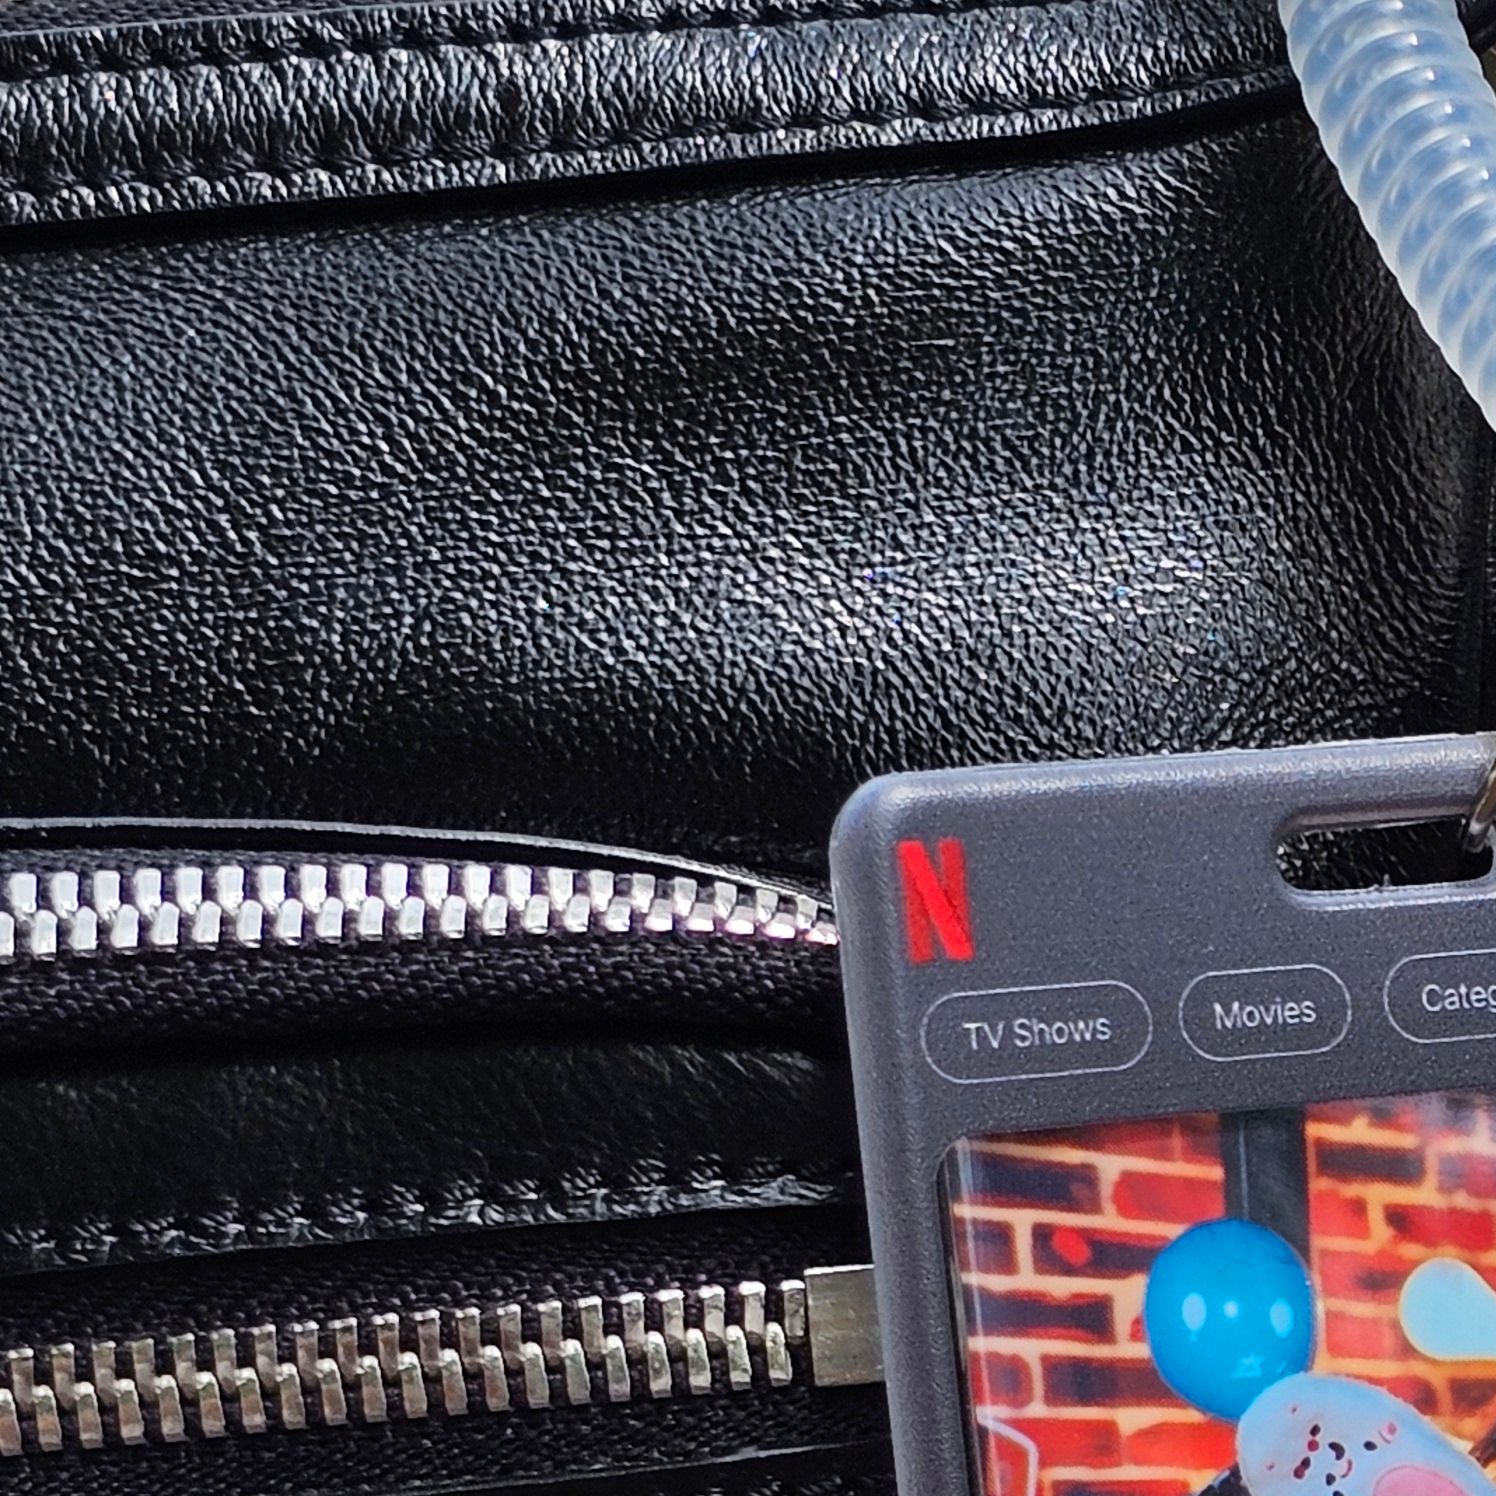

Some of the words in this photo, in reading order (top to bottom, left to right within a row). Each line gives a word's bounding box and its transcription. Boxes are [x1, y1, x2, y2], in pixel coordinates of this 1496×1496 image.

[1214, 998, 1317, 1031] Movies
[963, 1021, 1004, 1051] TV
[1014, 1017, 1112, 1047] Shows
